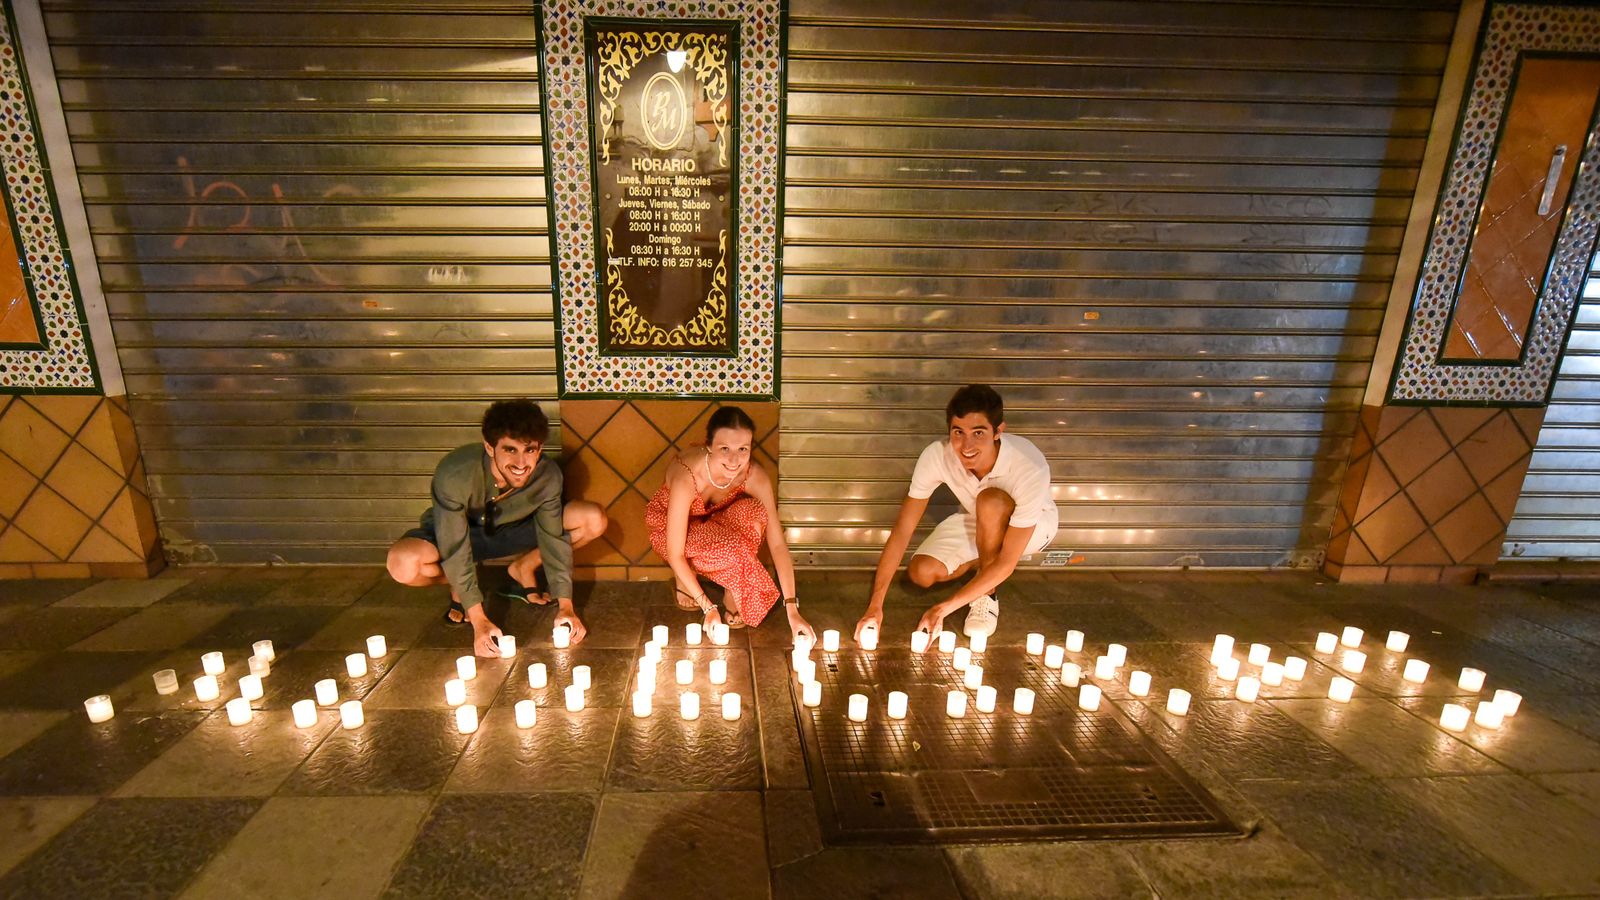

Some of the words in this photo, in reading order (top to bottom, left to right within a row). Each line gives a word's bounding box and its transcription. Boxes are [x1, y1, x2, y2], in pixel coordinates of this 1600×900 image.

[632, 158, 696, 172] HORARIO
[616, 174, 641, 185] Lunes,
[644, 175, 672, 186] Martes,
[675, 176, 711, 186] Miércoles
[629, 187, 652, 196] 08:00
[655, 188, 660, 196] H
[694, 189, 700, 197] H
[618, 198, 647, 209] Jueves,
[649, 199, 679, 210] Viernes,
[682, 199, 710, 209] Sábado
[655, 211, 660, 220] H
[694, 212, 700, 221] H
[629, 222, 651, 231] 20:00
[654, 223, 660, 231] H
[670, 223, 692, 232] 00:00
[695, 224, 700, 232] H
[649, 234, 681, 245] Domingo
[631, 245, 653, 254] 08:30
[656, 246, 661, 254] H
[672, 246, 691, 255] 16:30
[694, 247, 700, 255] H
[619, 257, 635, 266] TLF.
[638, 258, 659, 267] INFO:
[662, 258, 676, 267] 616
[679, 259, 694, 267] 257
[697, 259, 712, 268] 345
